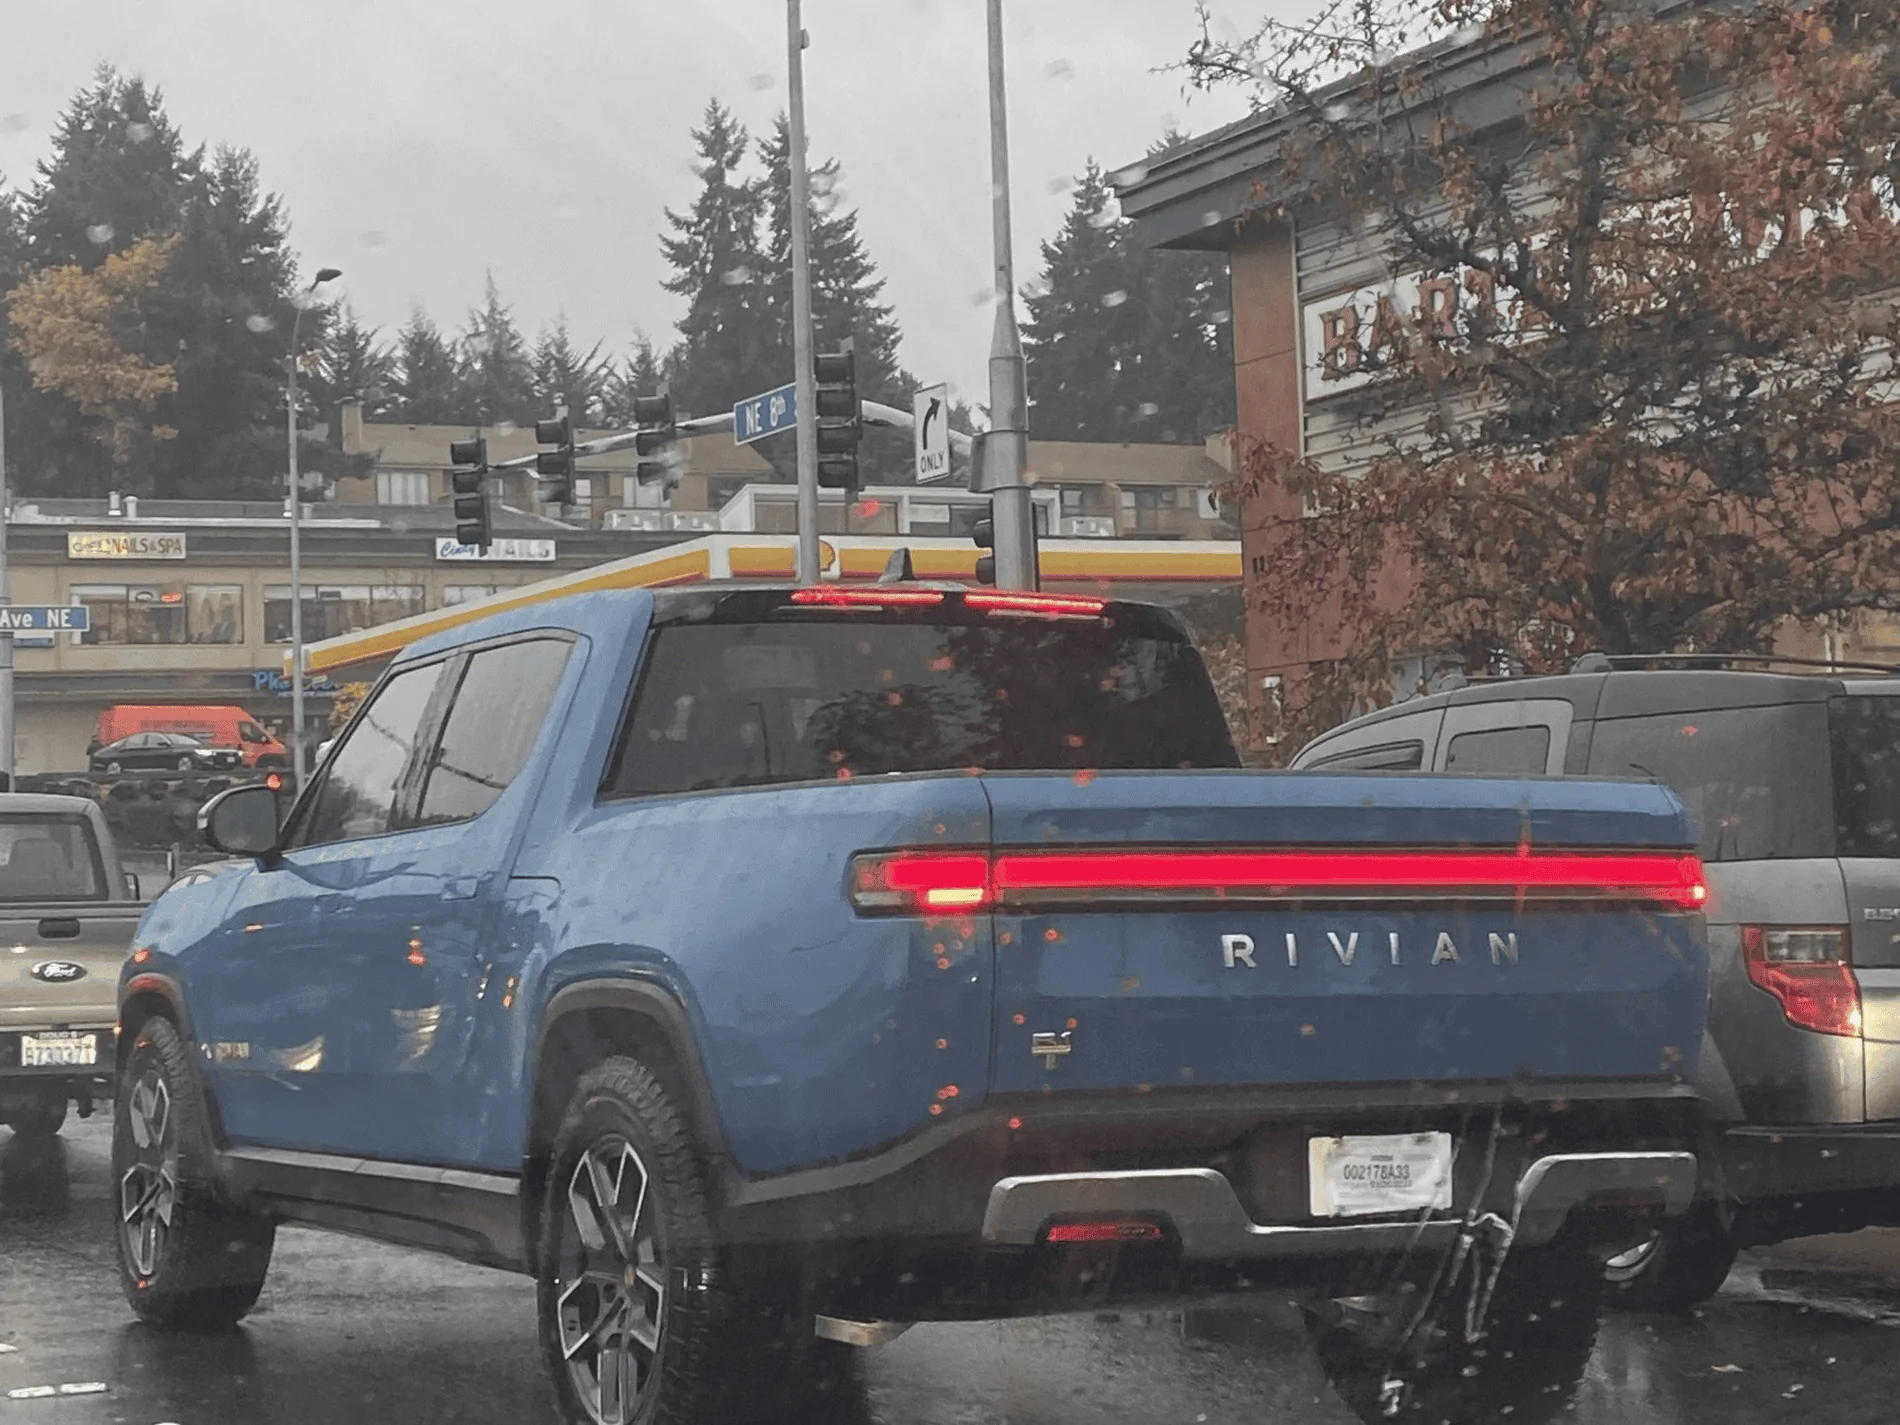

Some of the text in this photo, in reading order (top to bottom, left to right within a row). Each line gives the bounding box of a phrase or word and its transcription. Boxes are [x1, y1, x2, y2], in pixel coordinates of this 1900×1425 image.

[746, 402, 762, 435] NE
[770, 394, 786, 427] 8th
[920, 452, 944, 473] ONLY
[112, 538, 148, 554] NAILS
[158, 538, 182, 554] SPA
[0, 608, 72, 628] Ave NE
[1221, 931, 1519, 968] RIVIAN
[43, 963, 77, 978] Ford
